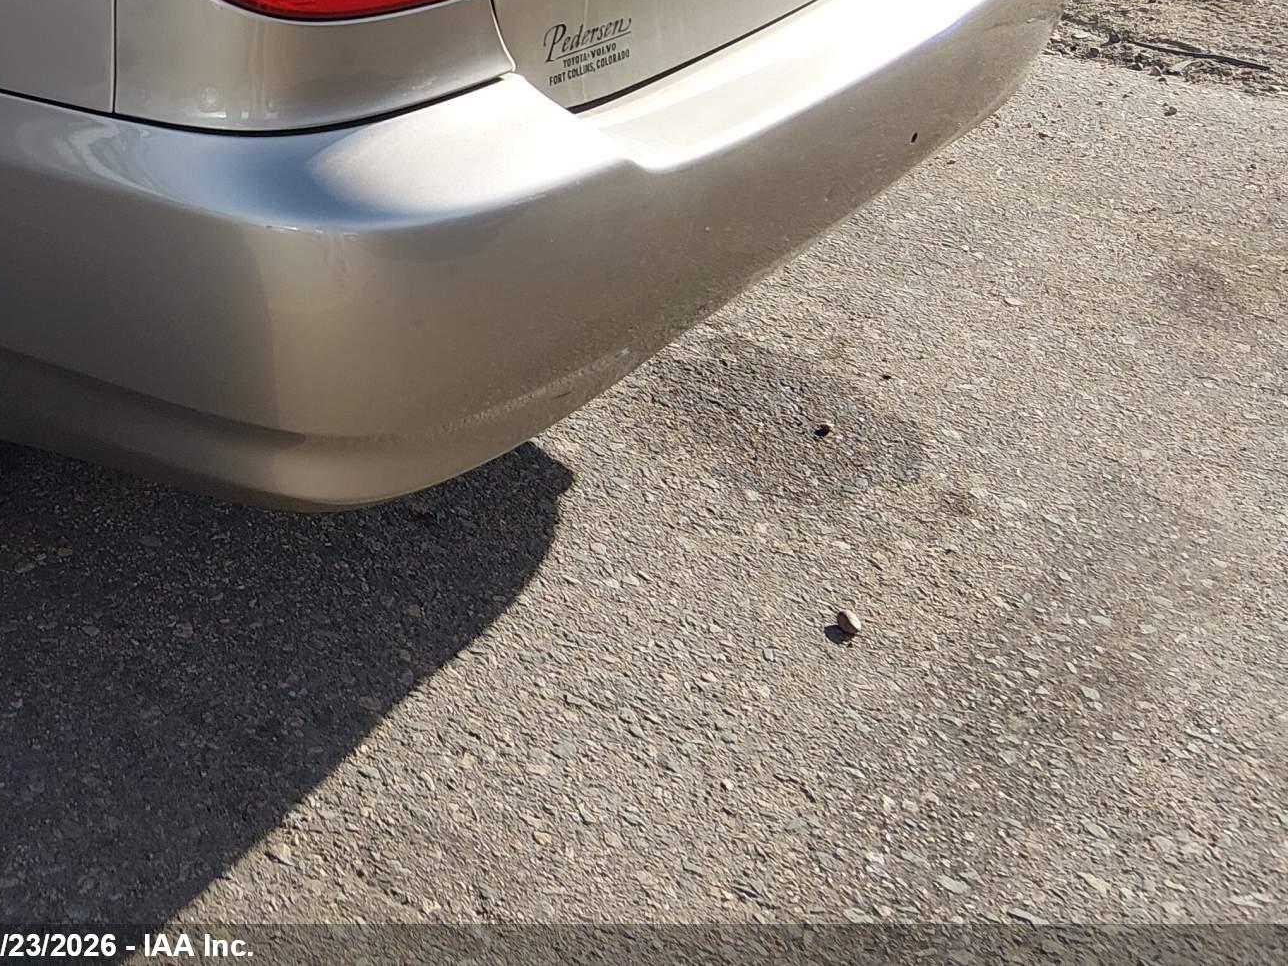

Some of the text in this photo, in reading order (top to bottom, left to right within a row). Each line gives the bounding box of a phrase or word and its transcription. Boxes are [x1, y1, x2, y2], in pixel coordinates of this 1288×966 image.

[543, 17, 632, 63] Pedersen
[549, 72, 566, 86] FORT
[596, 48, 630, 69] COLORADO
